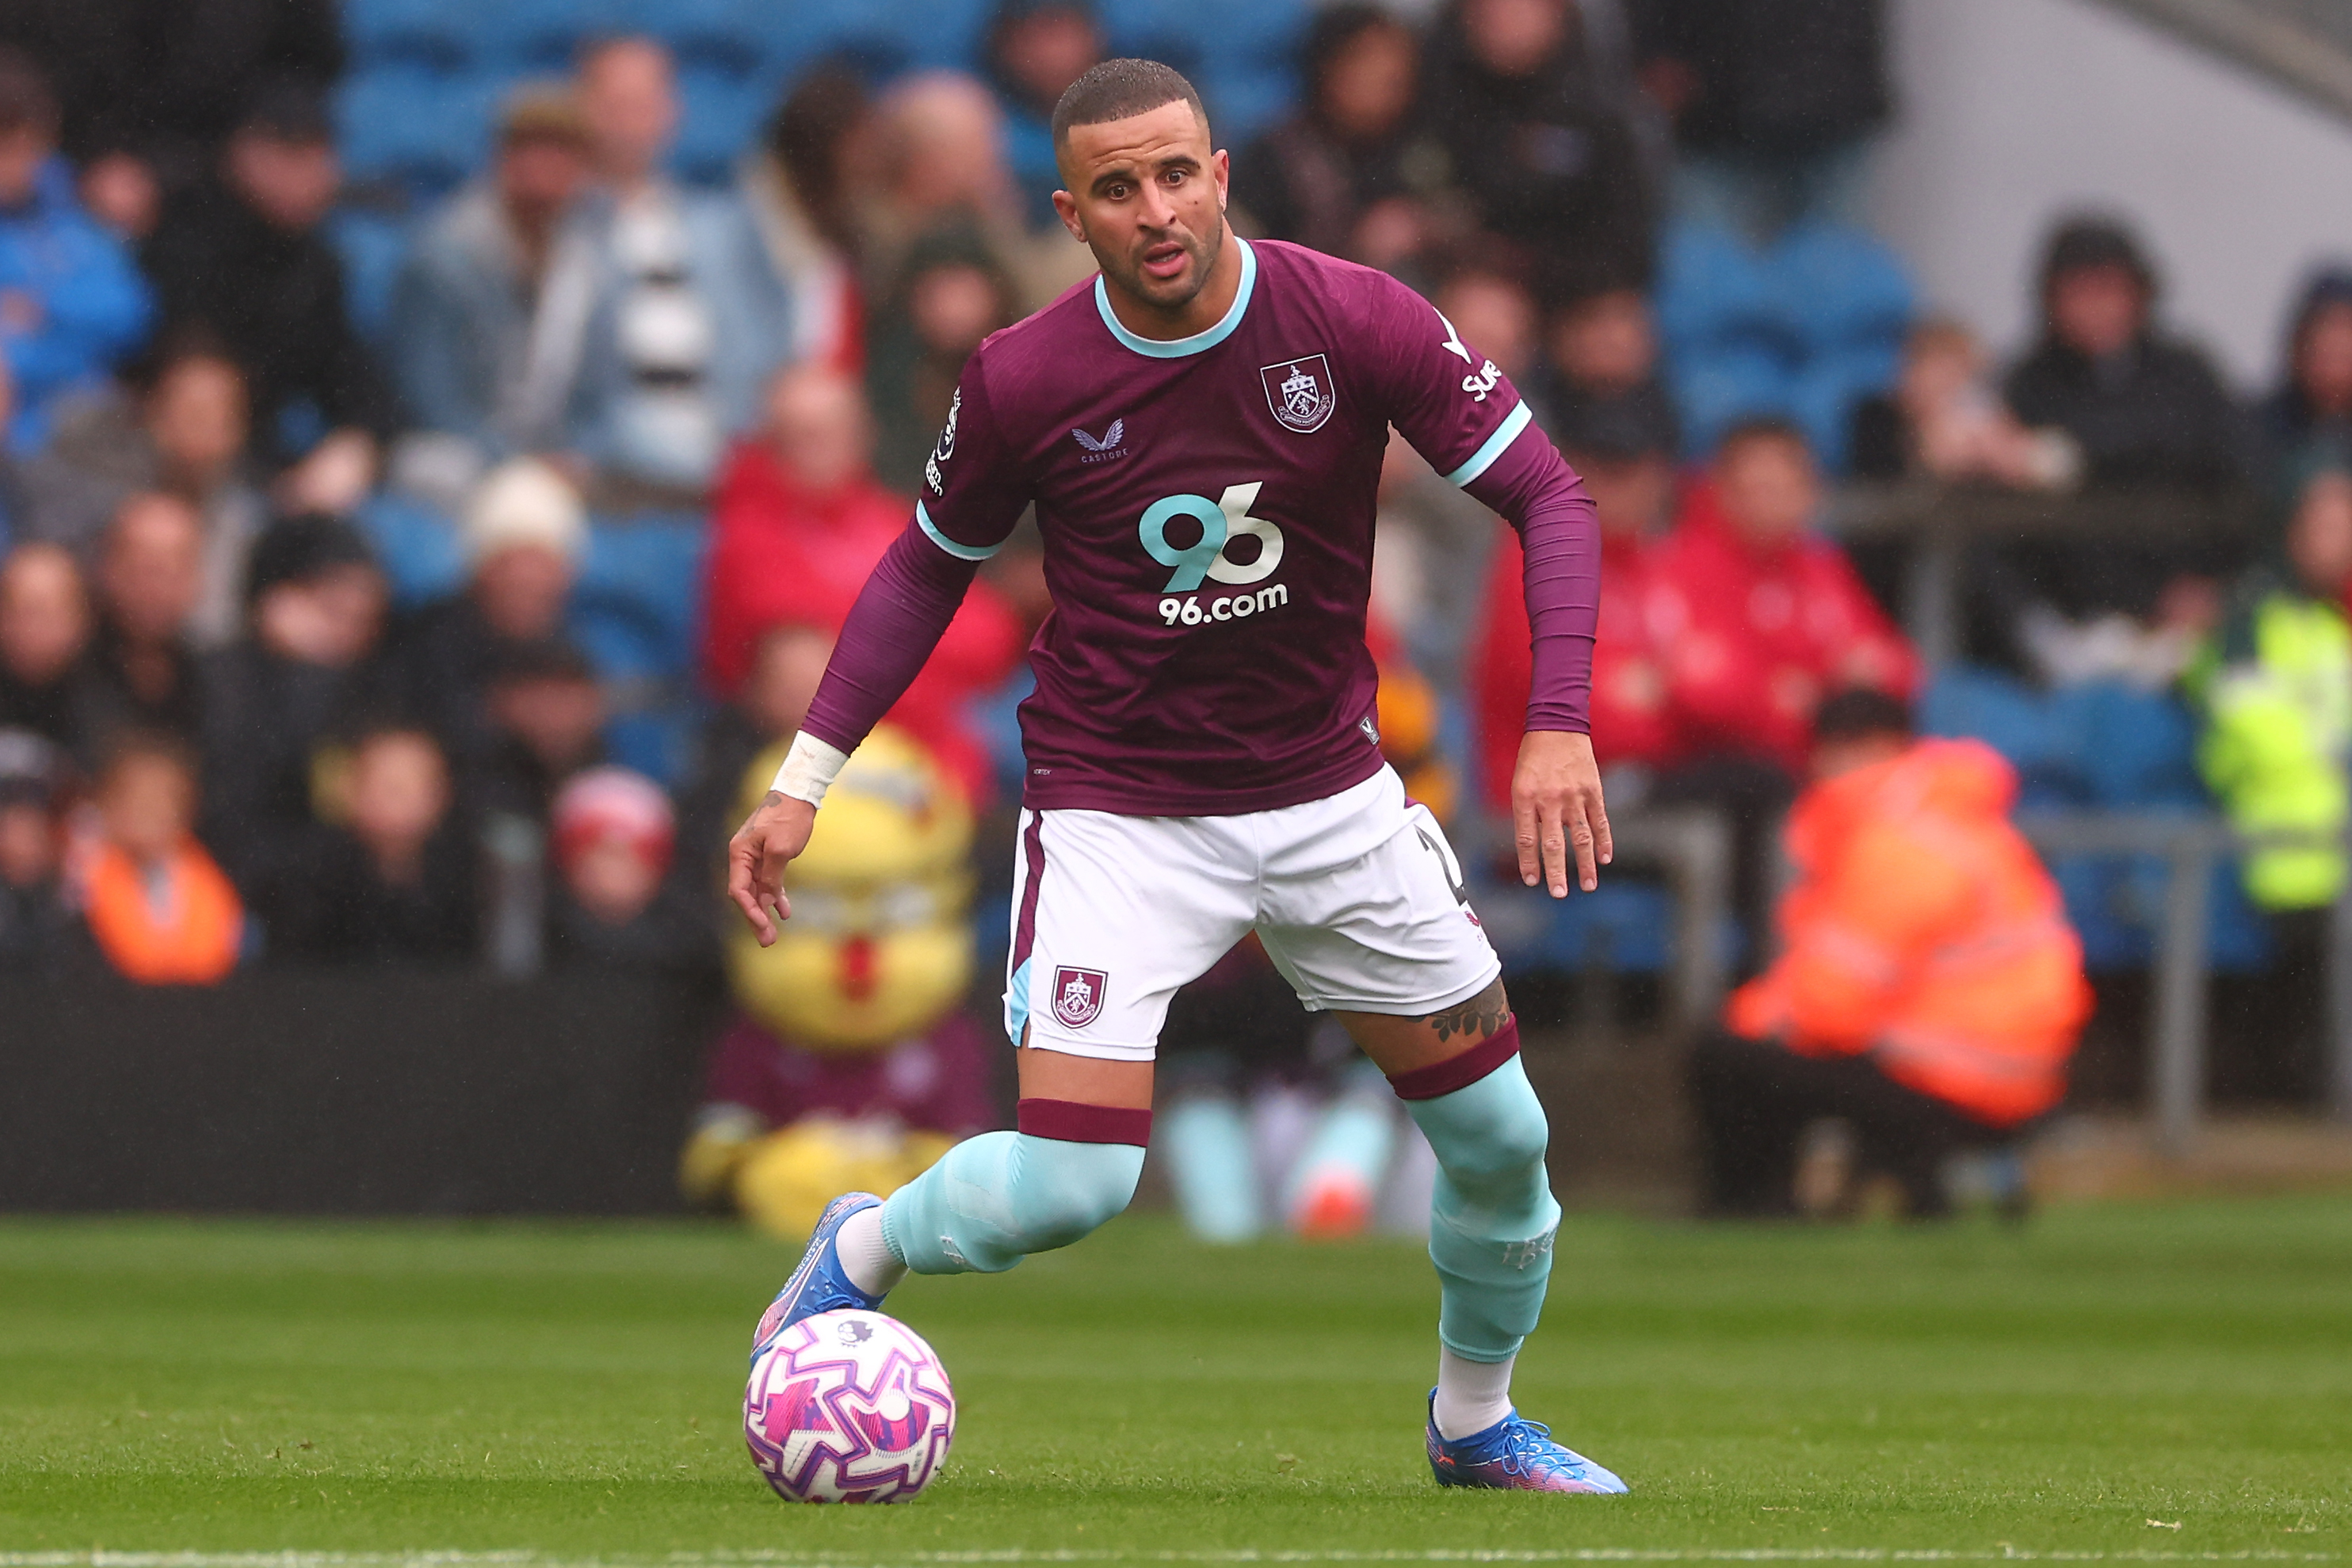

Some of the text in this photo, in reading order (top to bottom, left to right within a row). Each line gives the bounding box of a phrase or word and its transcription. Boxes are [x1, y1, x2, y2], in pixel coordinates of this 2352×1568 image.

[1462, 359, 1502, 402] Sure
[1081, 448, 1128, 463] CASTORE
[1139, 481, 1284, 593] 96
[1159, 583, 1289, 625] 96.com
